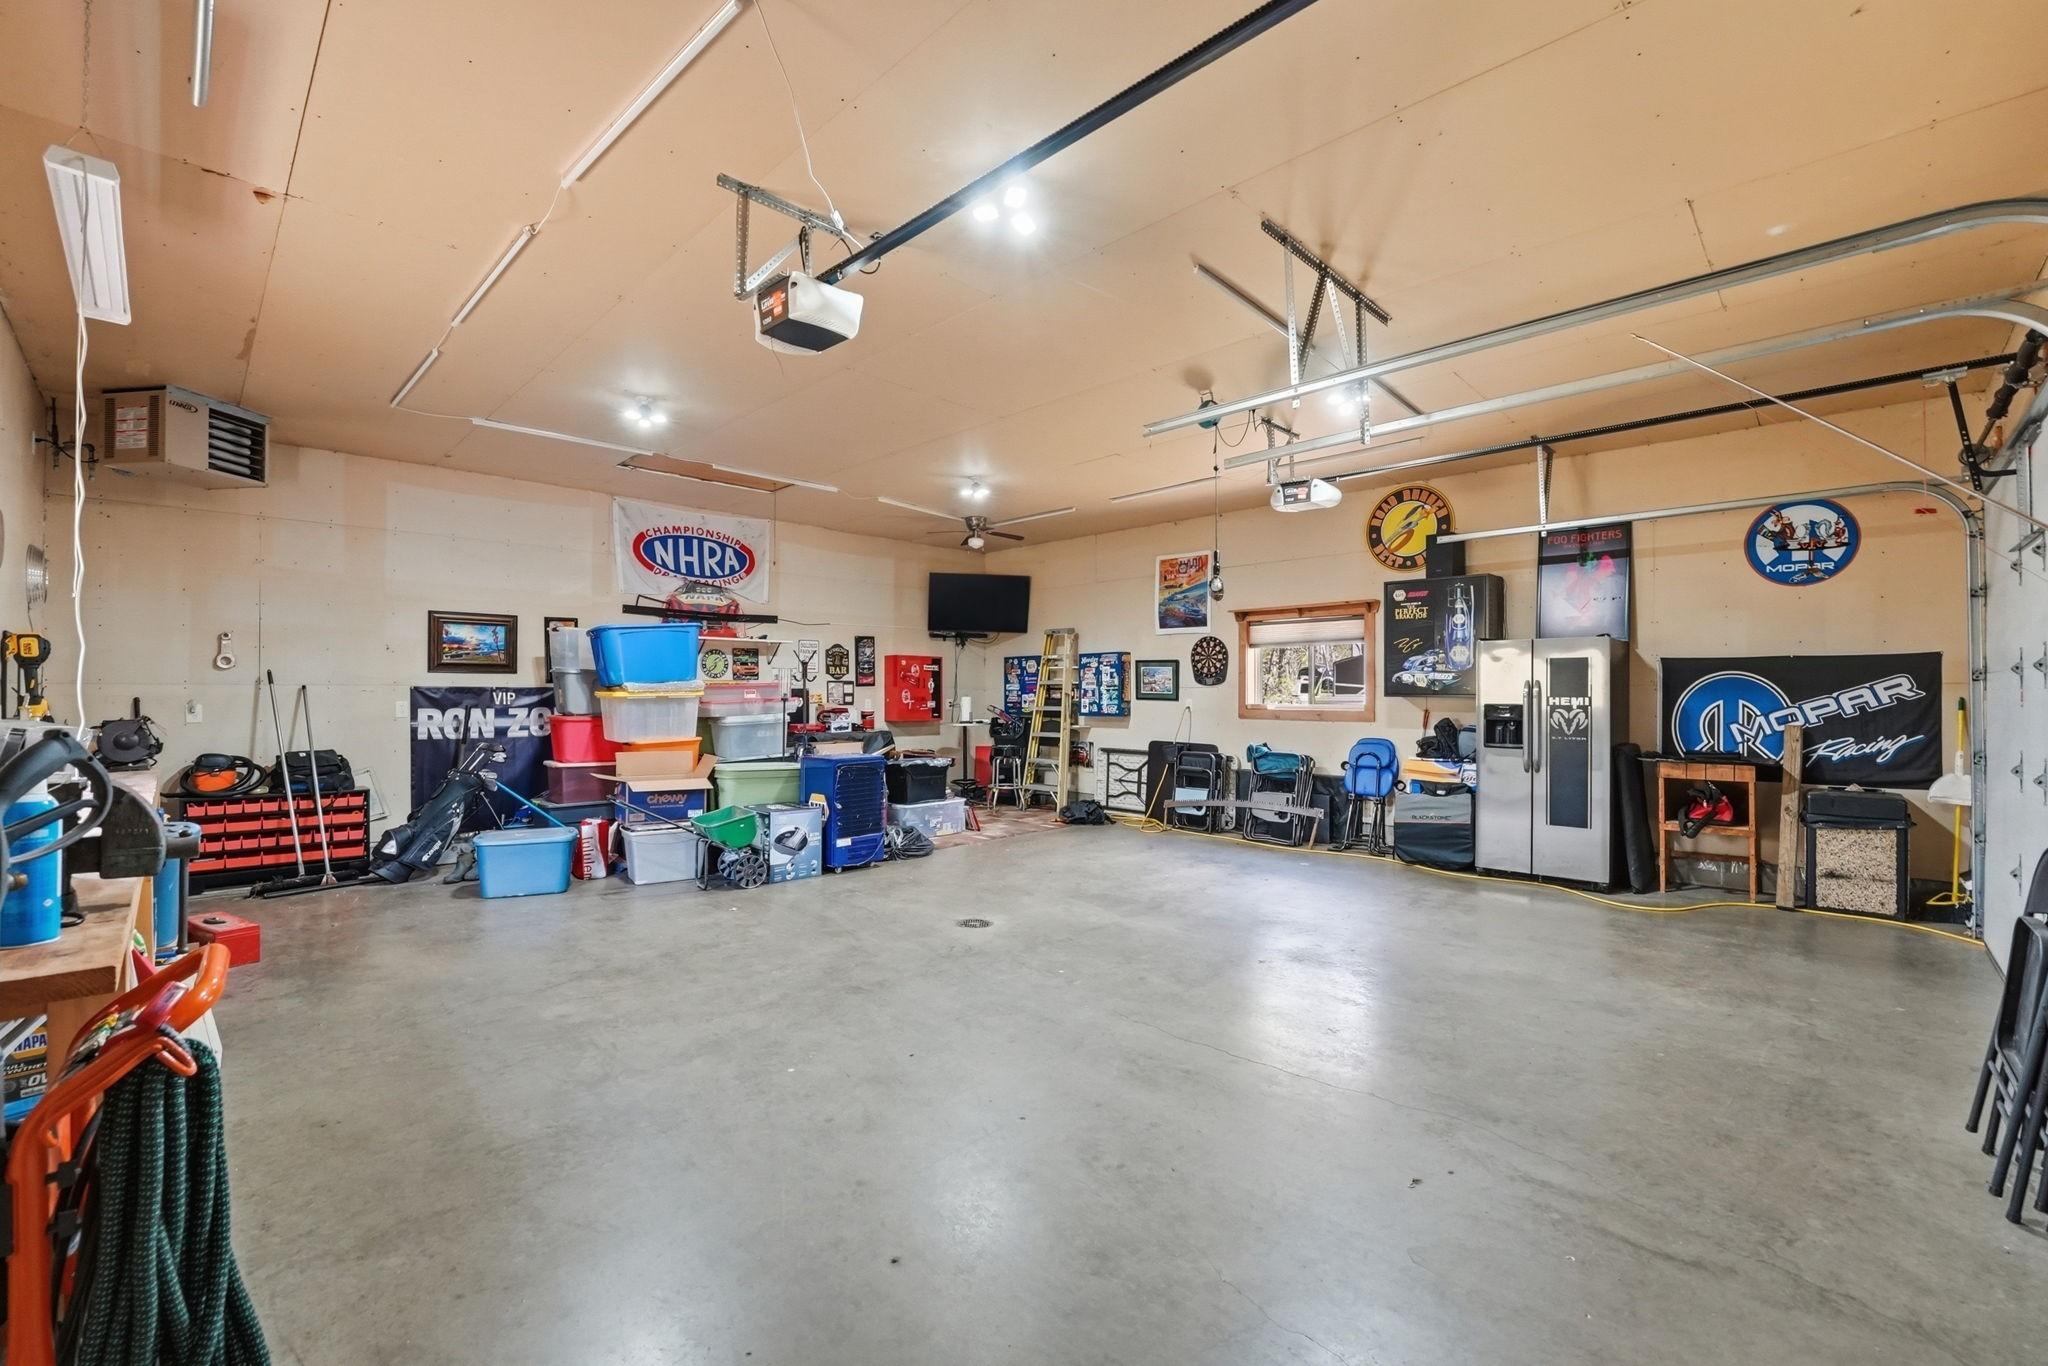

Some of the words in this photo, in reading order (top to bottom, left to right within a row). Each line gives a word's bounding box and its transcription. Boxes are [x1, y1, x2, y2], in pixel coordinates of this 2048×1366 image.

[1371, 495, 1398, 527] ROAD
[1402, 489, 1449, 519] RUNNER
[645, 525, 744, 548] CHAMPIONSHIP
[1547, 535, 1568, 545] FOO
[1570, 529, 1623, 542] FIGHTERS
[653, 537, 740, 577] NHRA
[1373, 543, 1404, 568] BEEP
[829, 666, 847, 674] BAR
[493, 692, 516, 705] VIP
[1549, 697, 1590, 710] HEMI
[1729, 673, 1926, 745] MOPAR
[417, 707, 495, 740] RON
[507, 706, 557, 738] ZO
[1801, 733, 1925, 768] Racing
[646, 793, 687, 805] chewy
